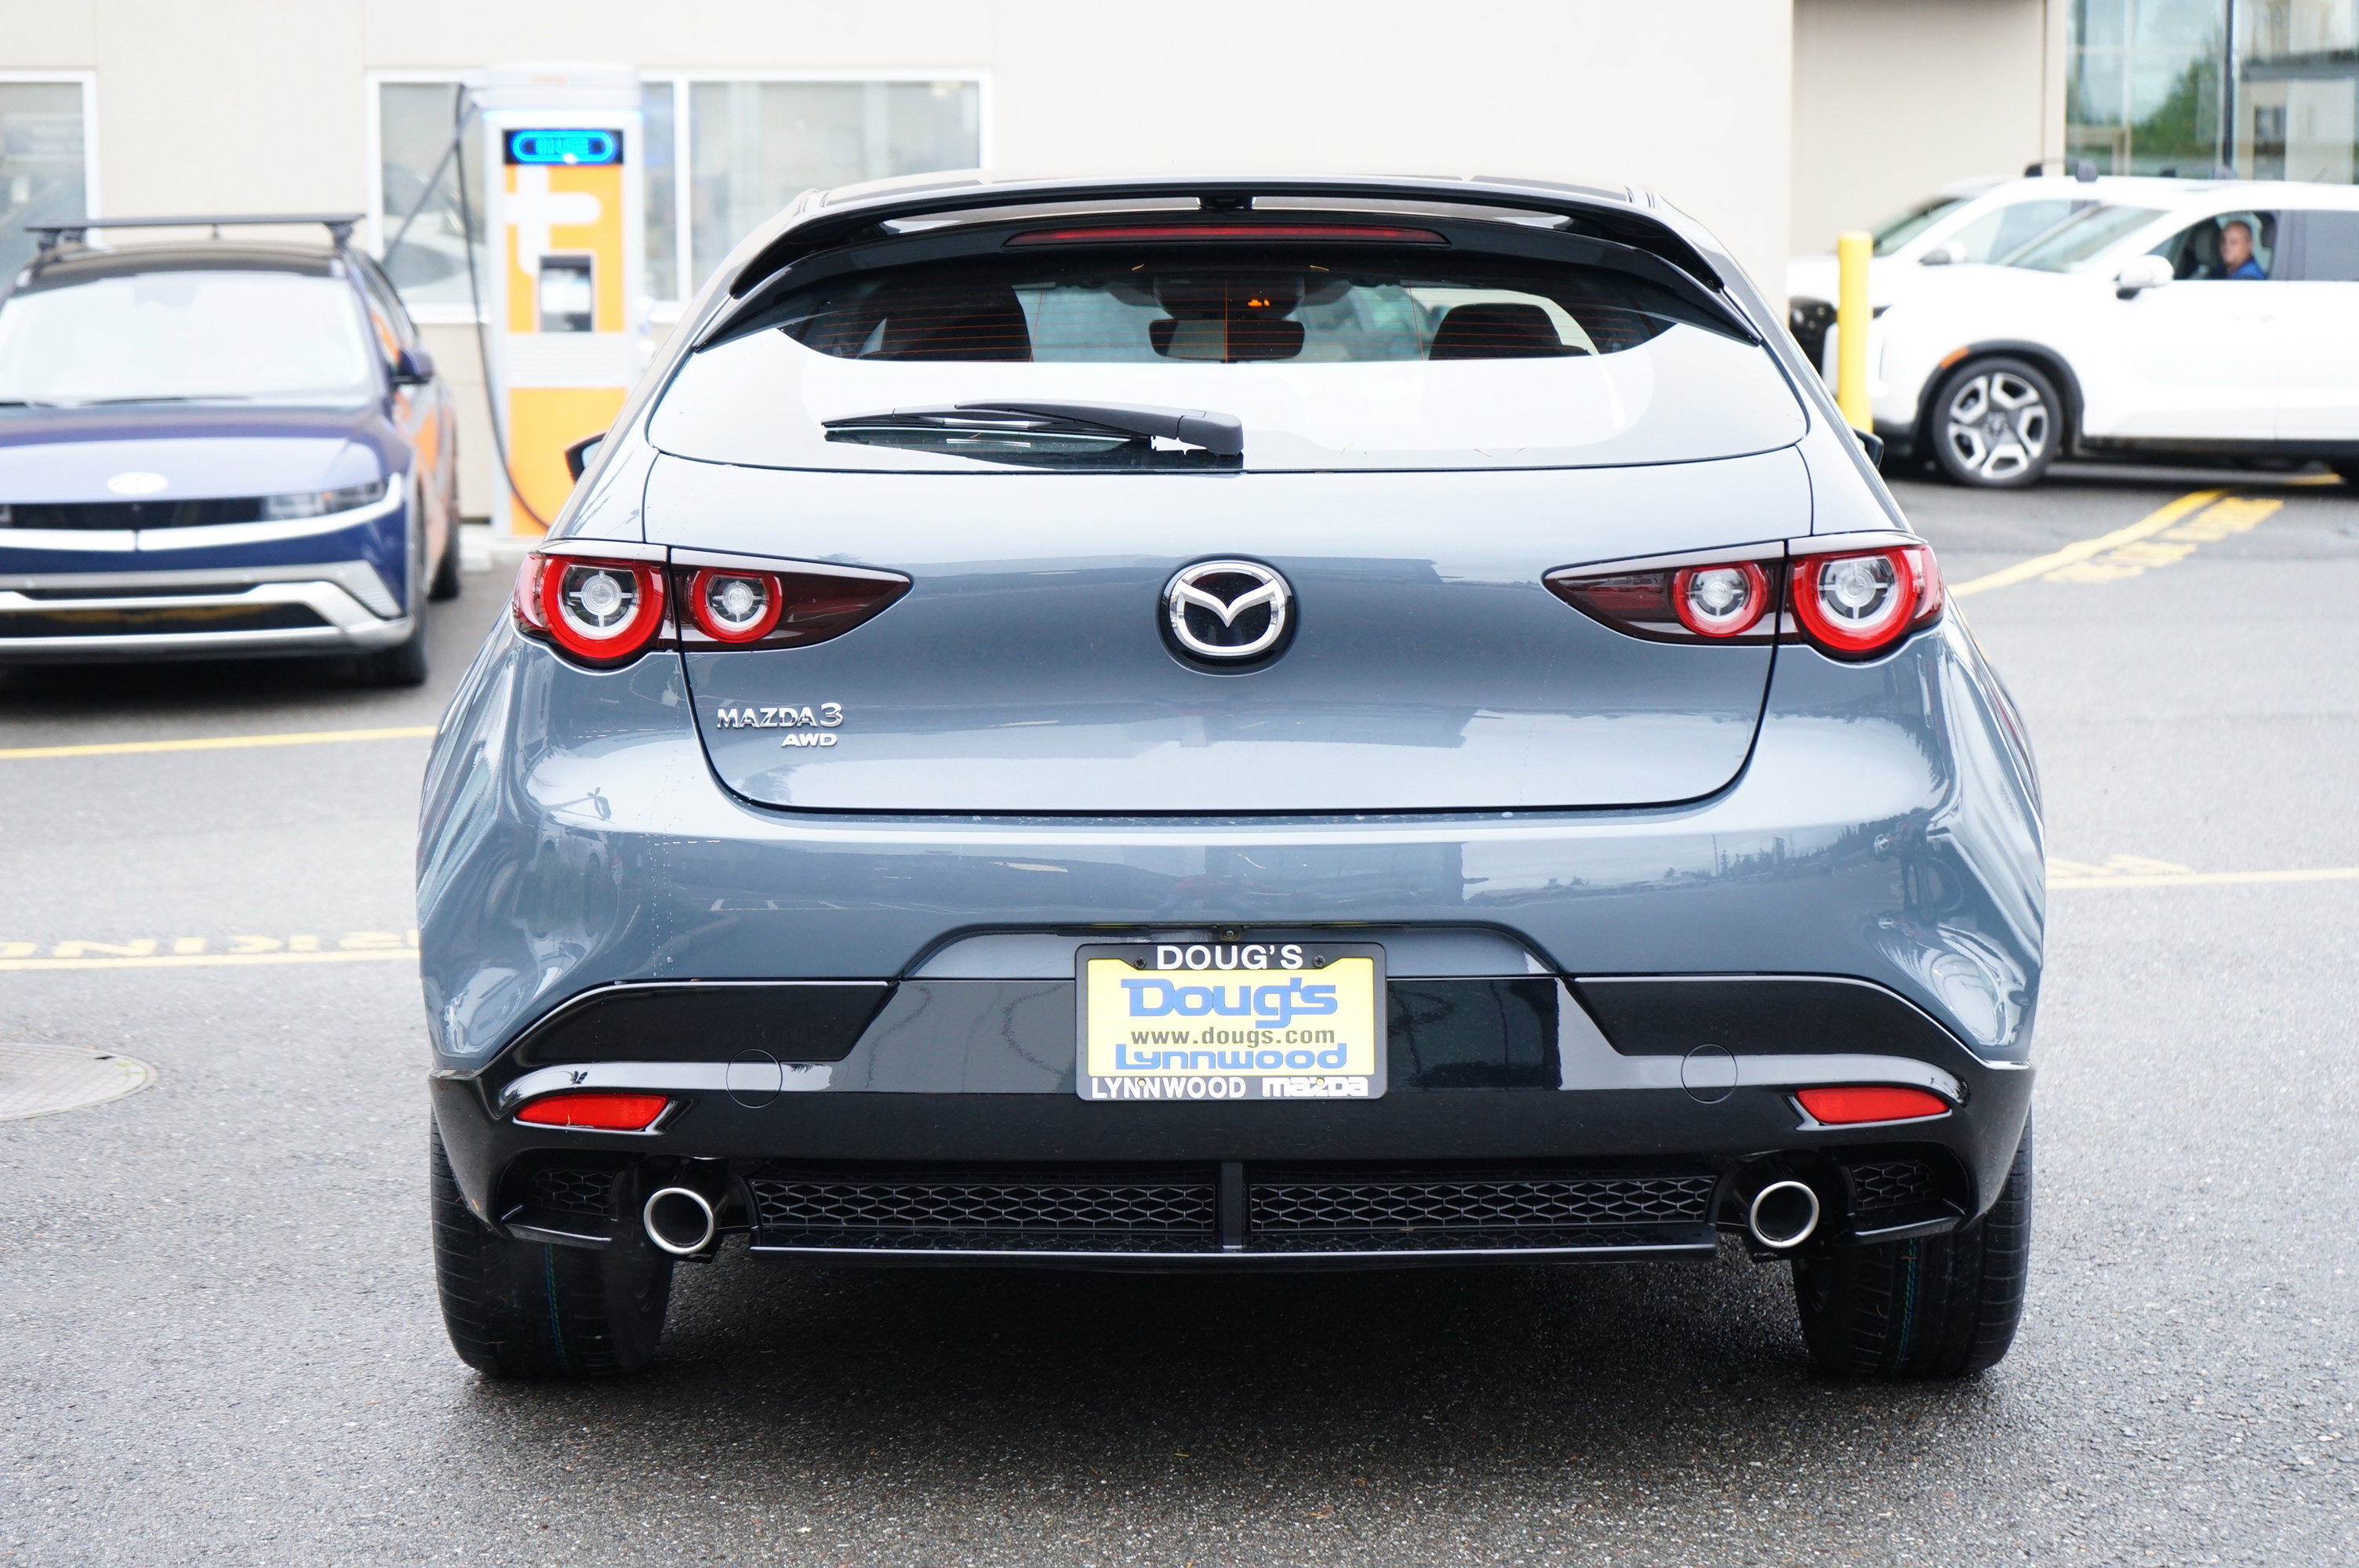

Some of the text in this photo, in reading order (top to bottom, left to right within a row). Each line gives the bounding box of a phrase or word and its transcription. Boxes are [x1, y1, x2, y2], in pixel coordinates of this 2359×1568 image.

[781, 733, 838, 747] AWD
[1157, 945, 1303, 970] DOUG'S
[1121, 977, 1338, 1029] Doug's
[1131, 1026, 1335, 1047] www.dougs.com
[1115, 1043, 1347, 1069] Lynnwood
[1091, 1076, 1246, 1098] LYNNWOOD
